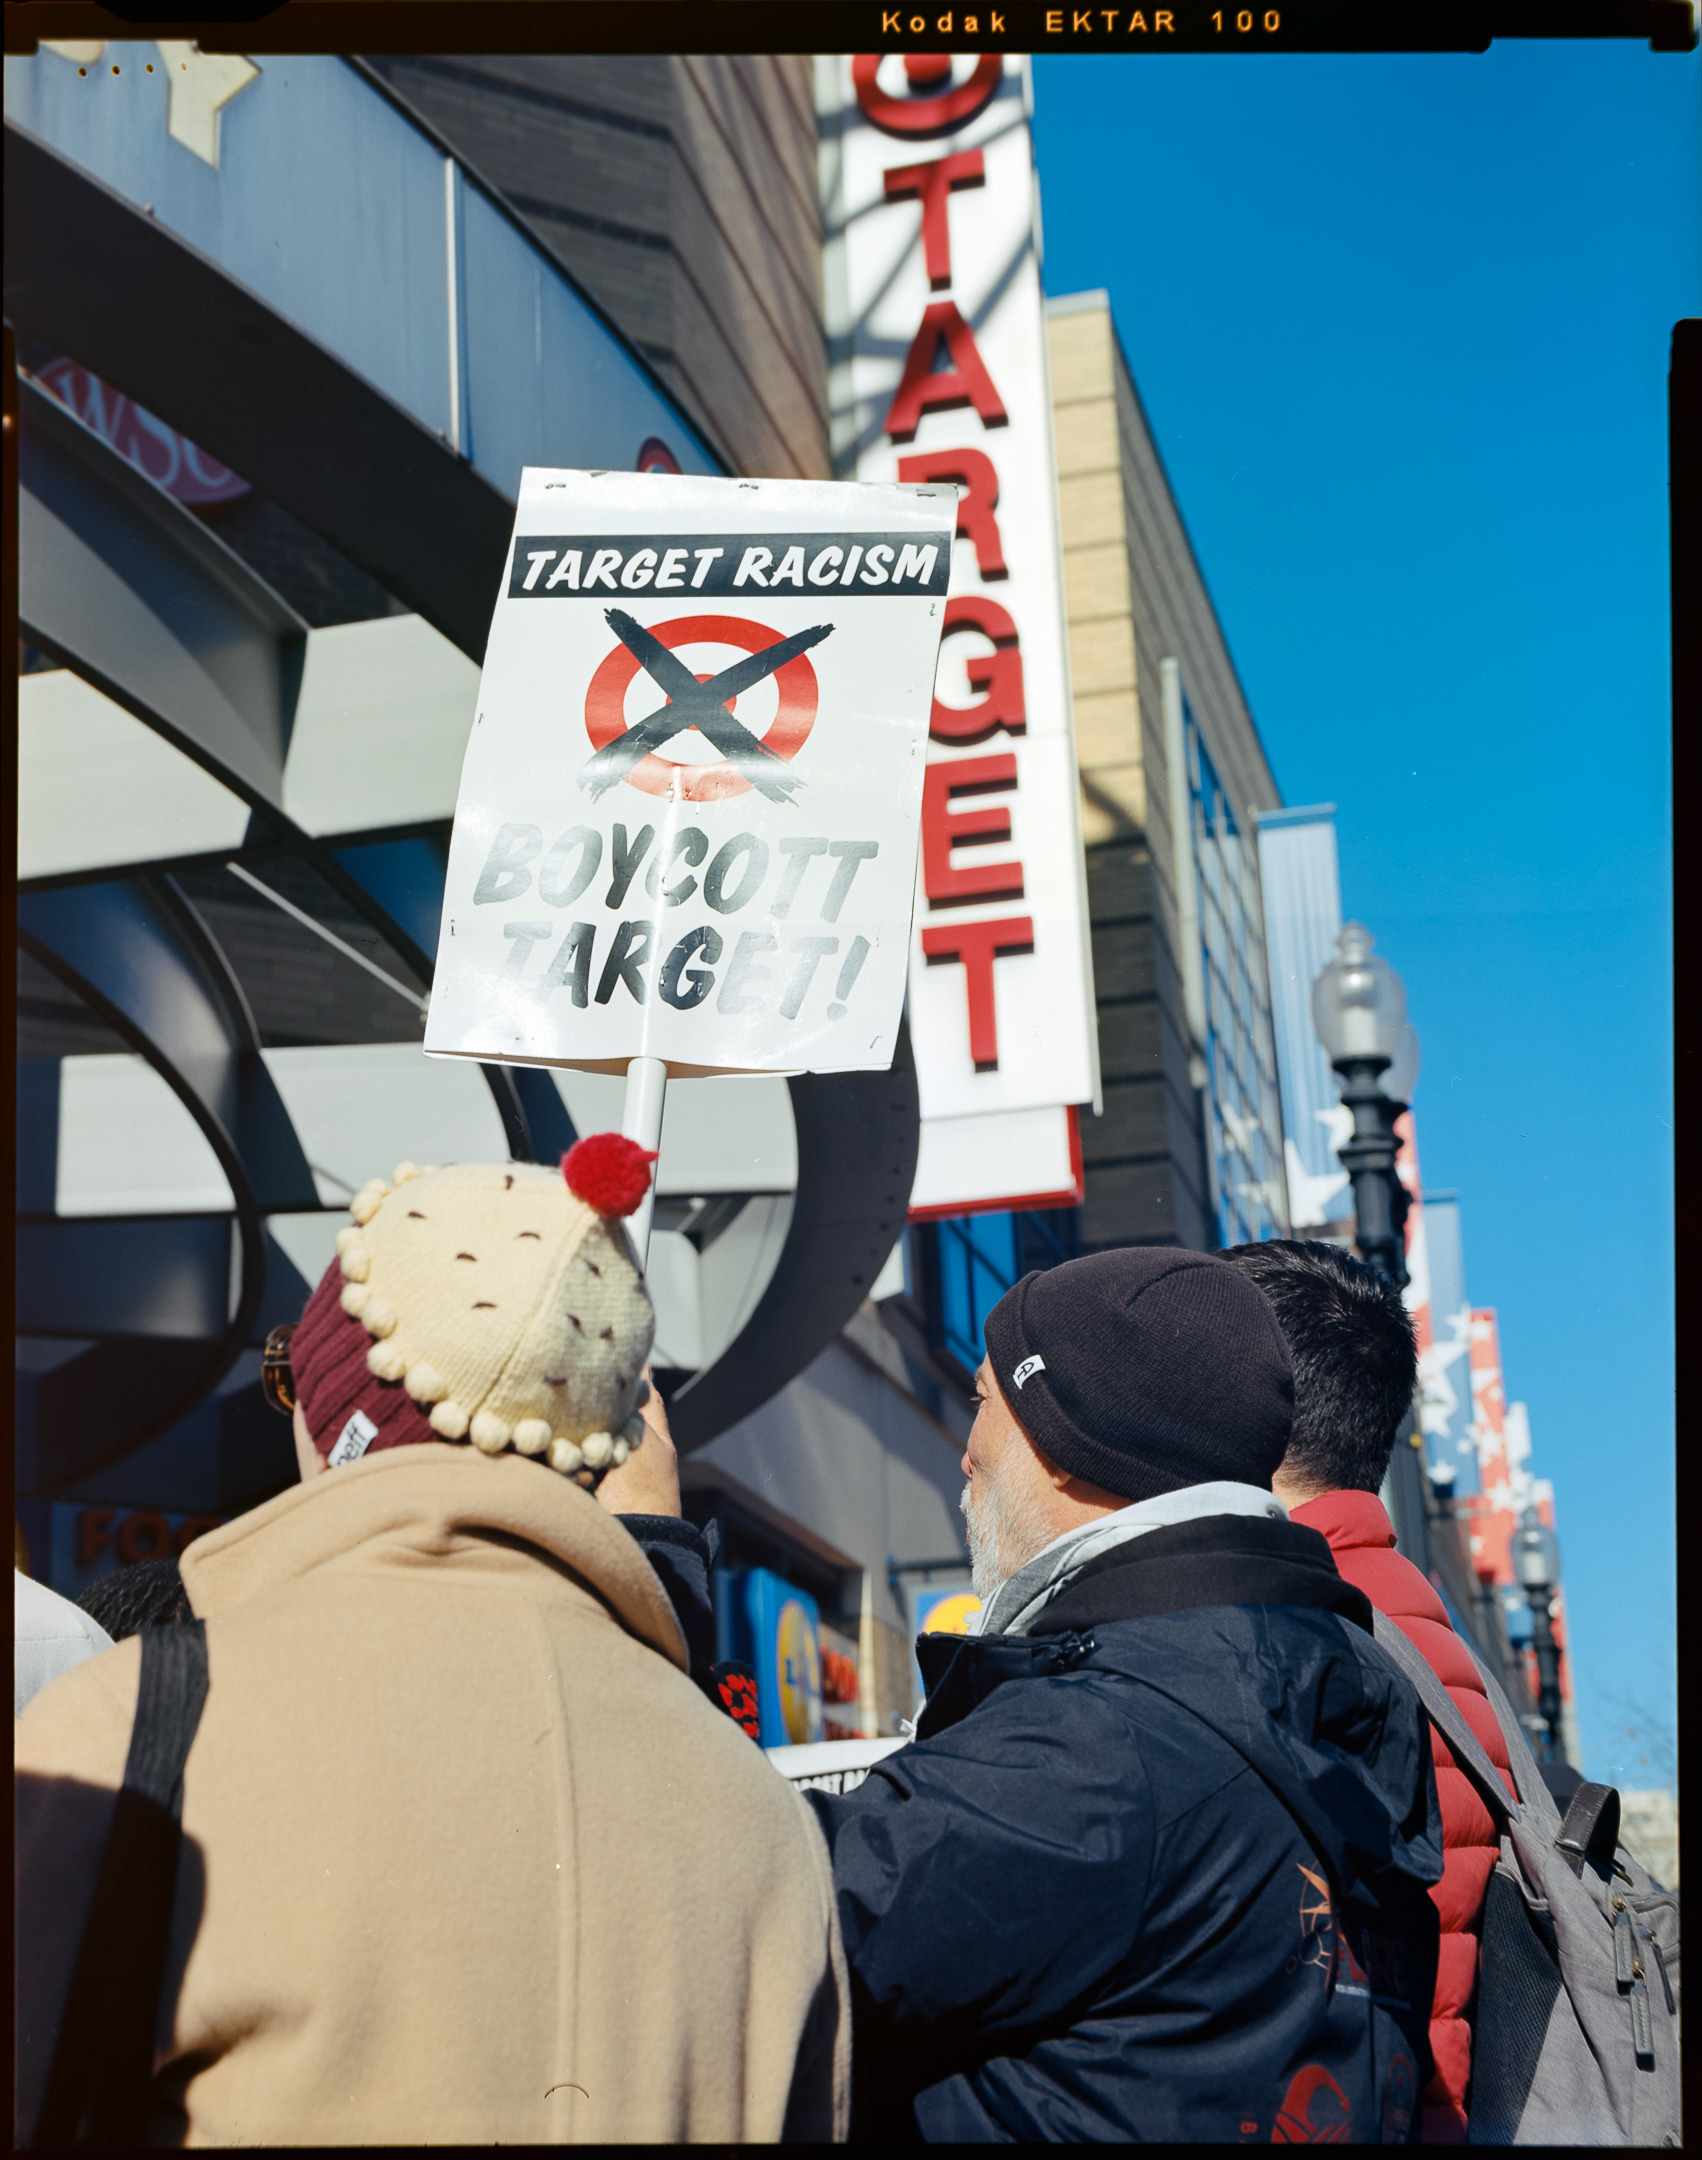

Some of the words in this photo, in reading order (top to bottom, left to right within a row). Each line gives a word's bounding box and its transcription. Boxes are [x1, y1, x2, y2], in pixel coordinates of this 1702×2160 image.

[521, 547, 724, 590] TARGET
[732, 543, 939, 588] RACISM
[883, 150, 1035, 1074] TARGET
[473, 822, 879, 924] BOYCOTT
[502, 919, 871, 1022] TARGET!
